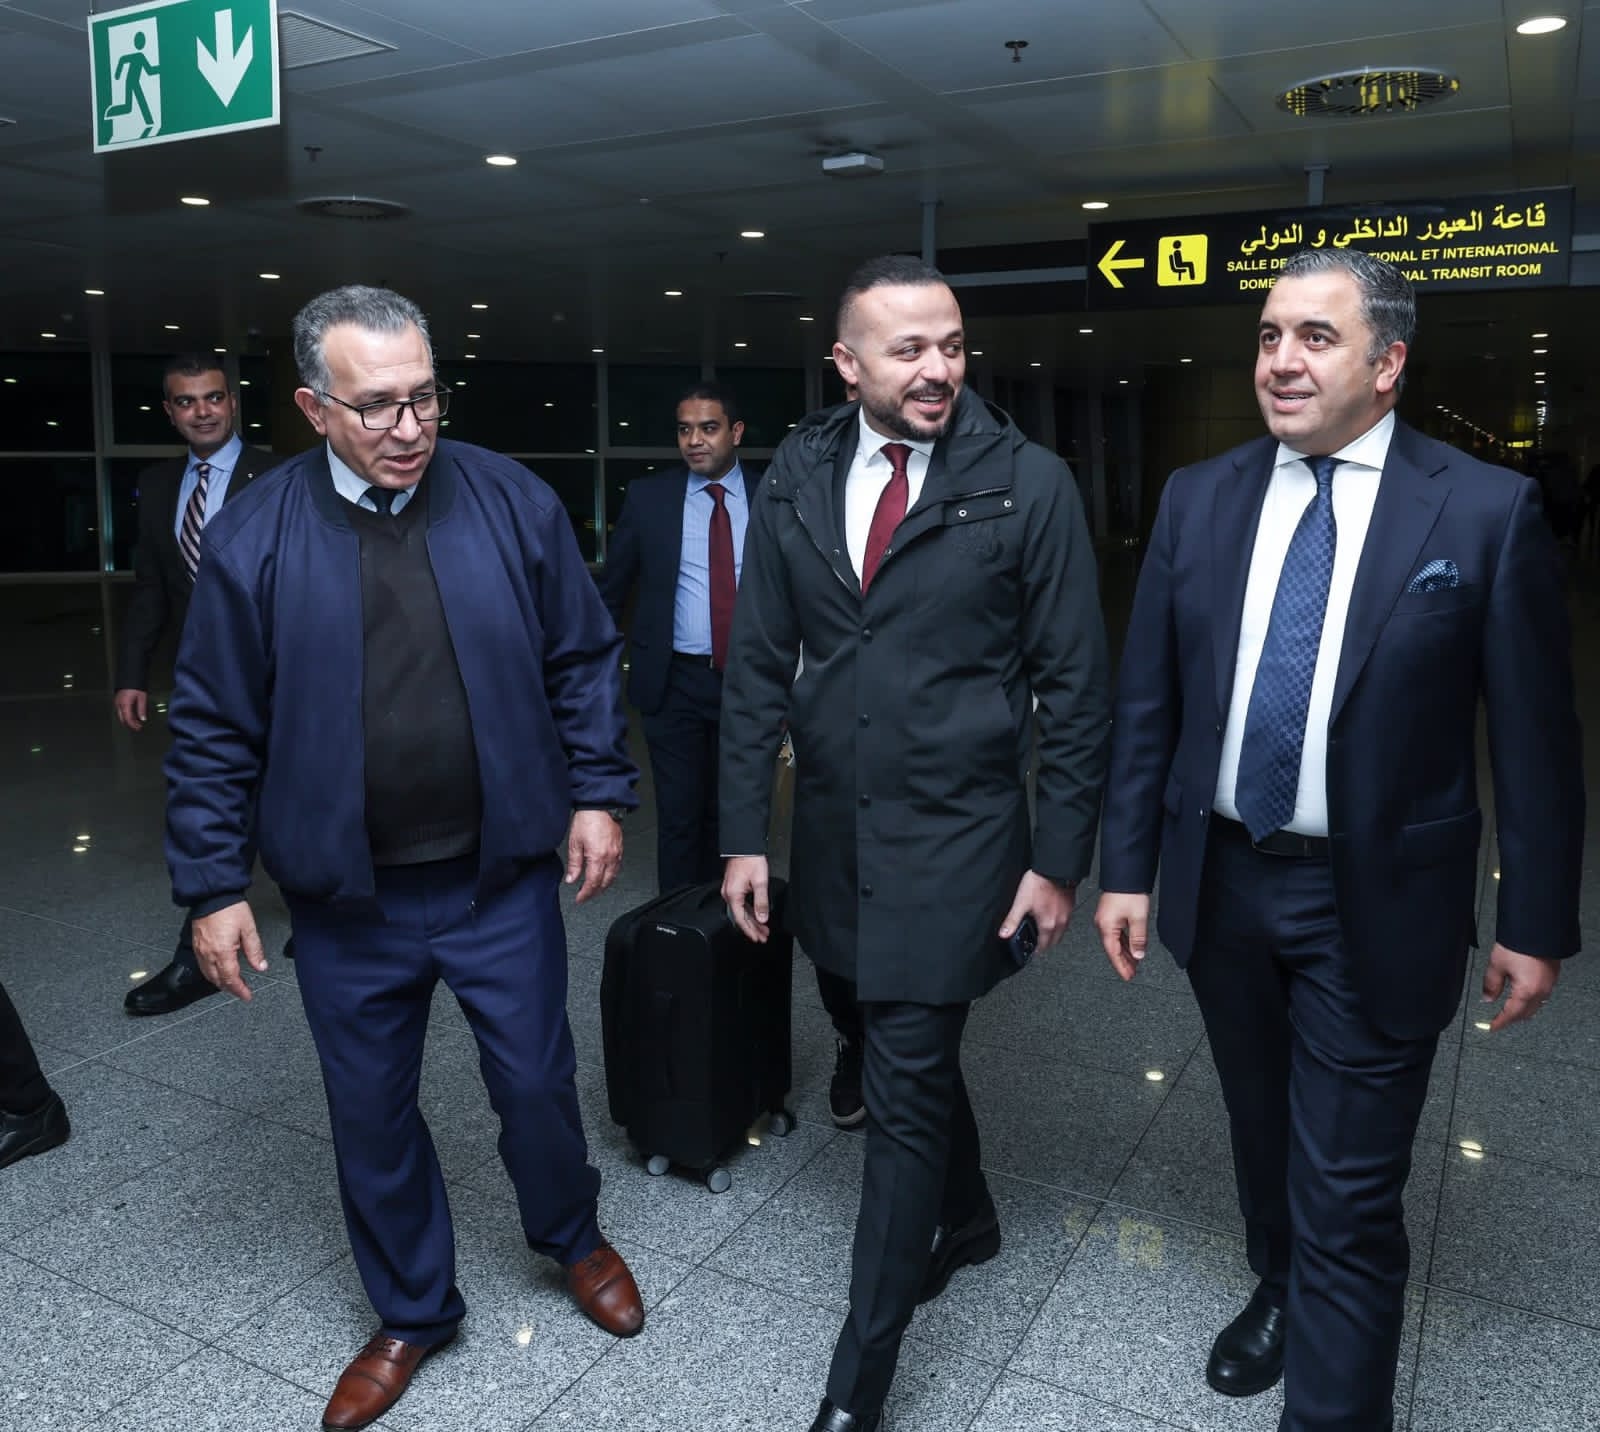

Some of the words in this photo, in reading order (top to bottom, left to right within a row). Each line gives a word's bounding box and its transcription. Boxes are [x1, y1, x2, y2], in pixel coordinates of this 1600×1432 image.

[1416, 209, 1484, 241] العبور
[1491, 202, 1546, 229] قاعة
[1240, 223, 1303, 256] الدولي
[1311, 228, 1326, 248] و
[1333, 215, 1409, 248] الداخلي
[1226, 259, 1268, 272] SALLE
[1421, 248, 1440, 261] ET
[1442, 241, 1559, 260] INTERNATIONAL
[1239, 278, 1276, 290] DOME
[1432, 266, 1493, 281] TRANSIT
[1496, 263, 1542, 278] ROOM
